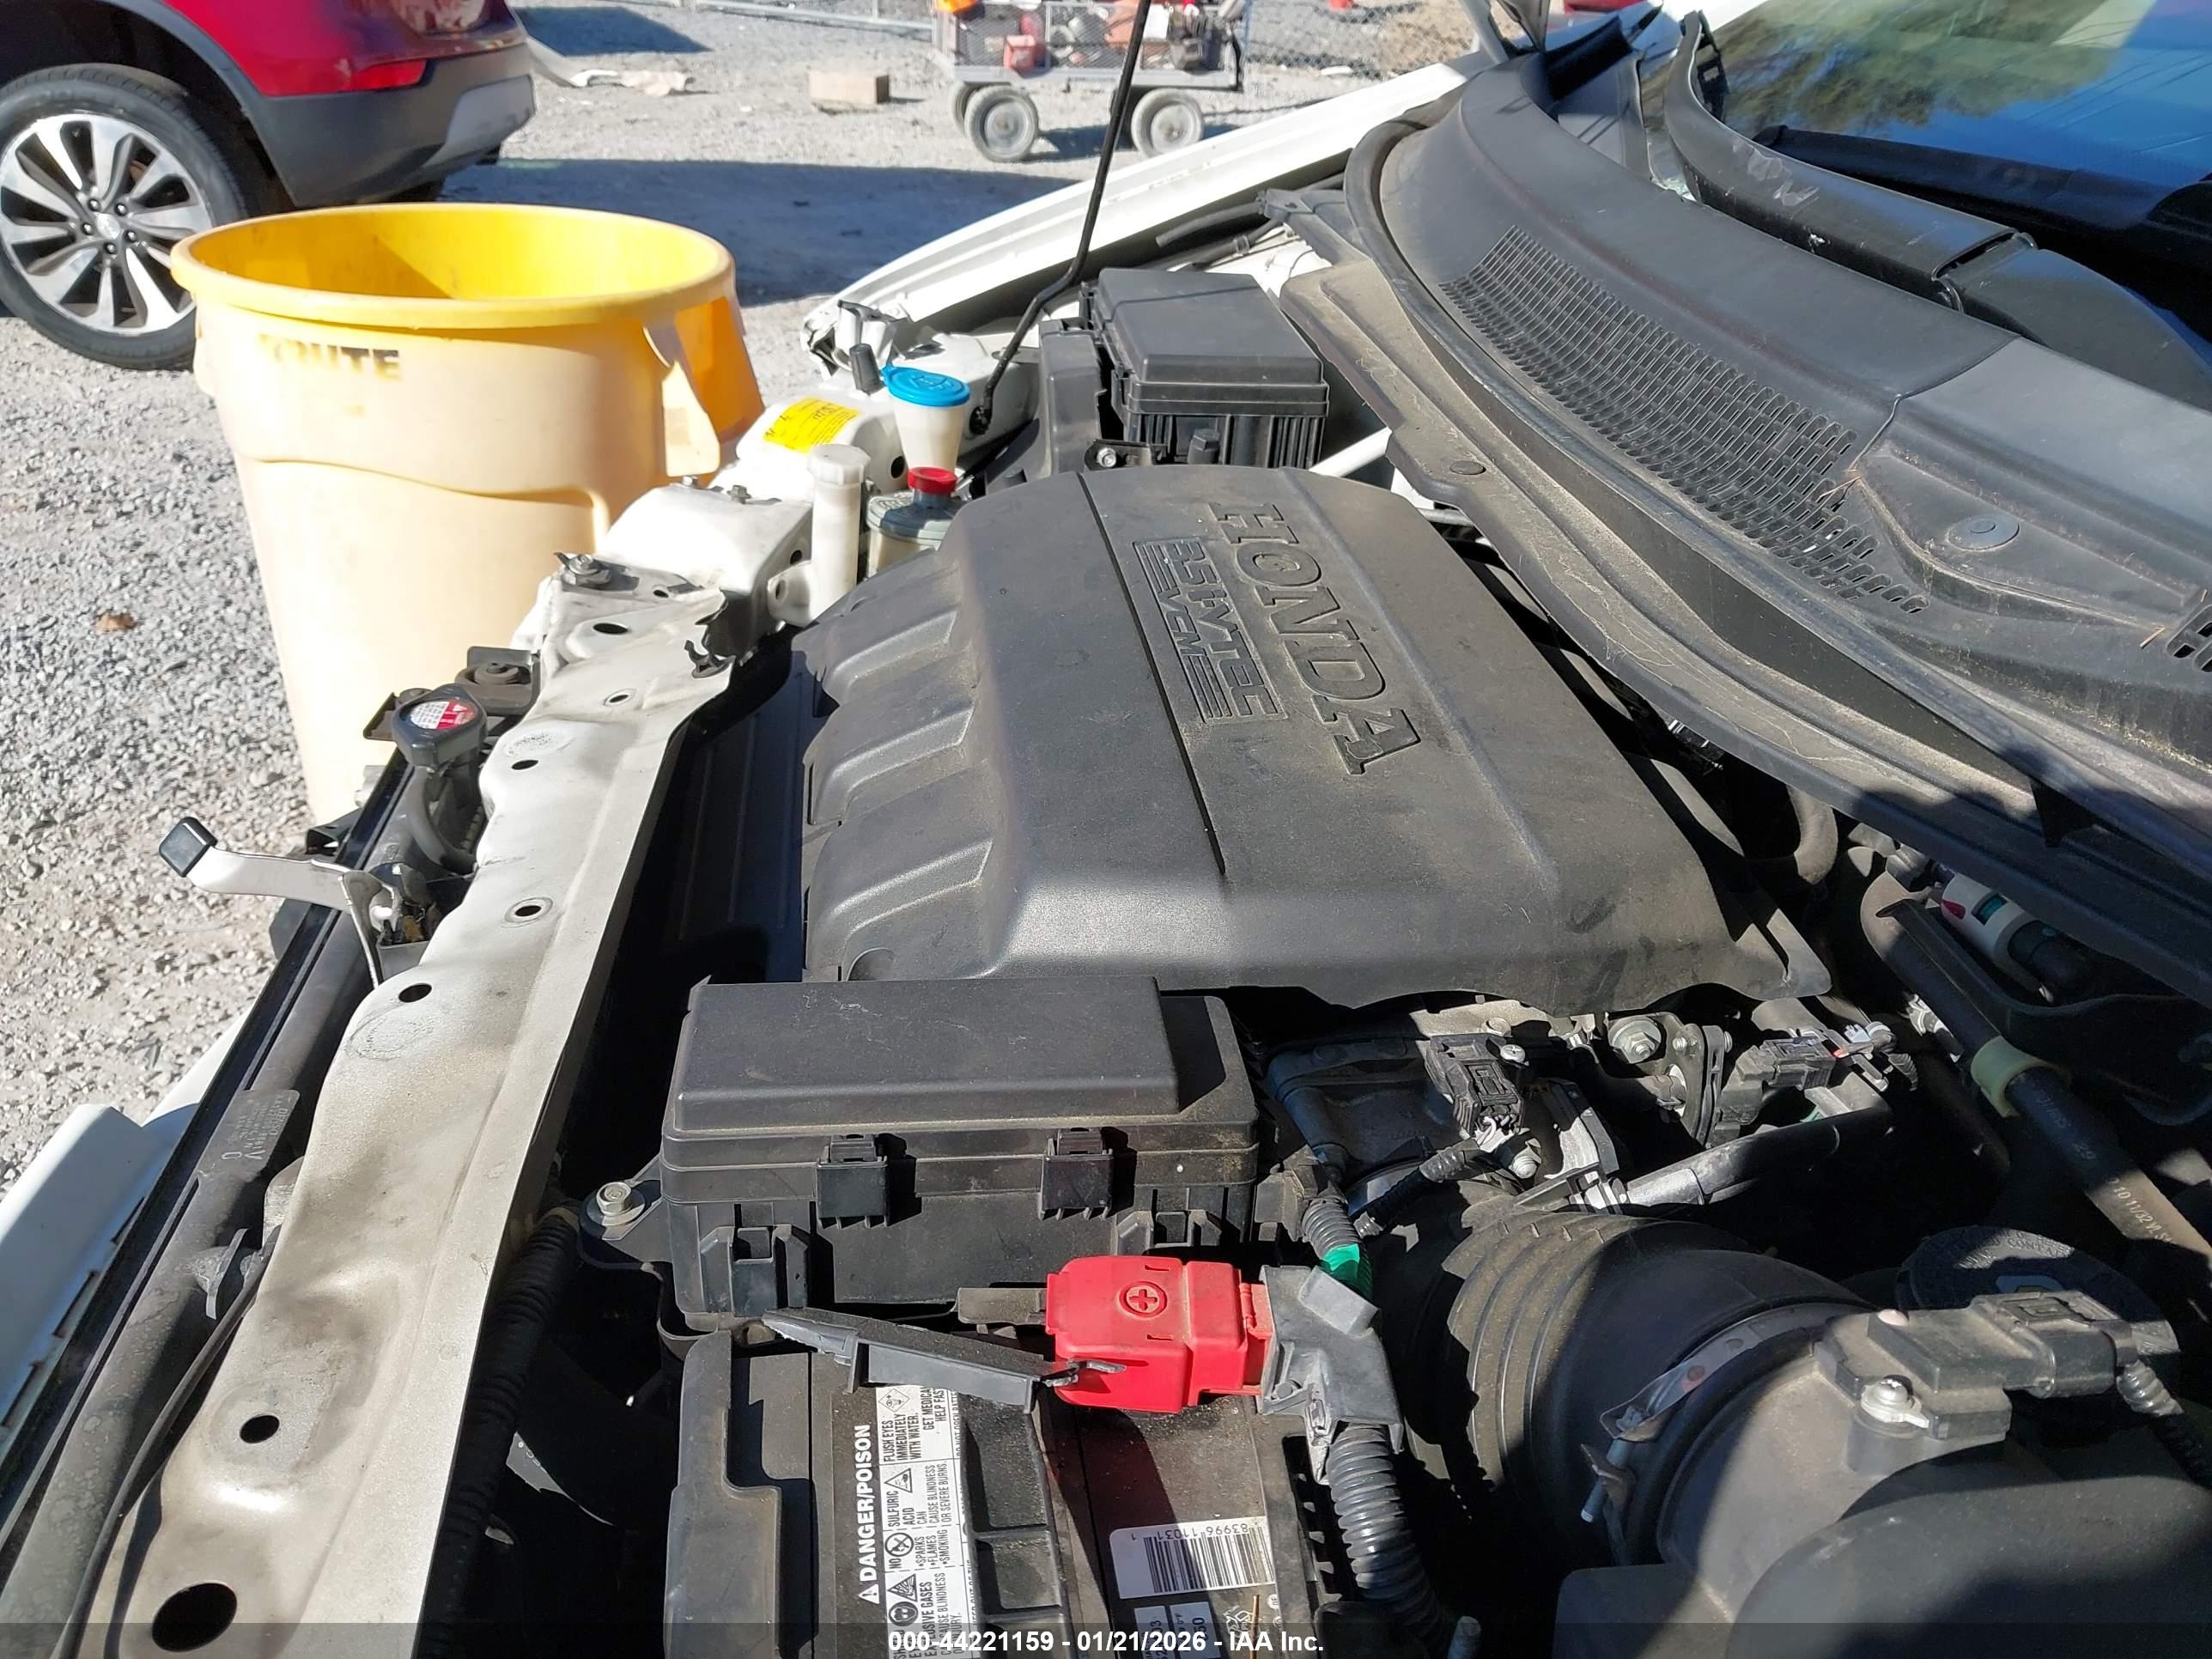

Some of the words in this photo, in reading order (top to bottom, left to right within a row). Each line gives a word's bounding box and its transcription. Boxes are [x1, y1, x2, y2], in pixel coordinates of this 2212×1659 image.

[1158, 586, 1207, 657] VCM
[1207, 502, 1422, 775] HONDA
[269, 1108, 289, 1135] DENSO
[922, 1417, 934, 1431] GET
[934, 1405, 946, 1422] HELP
[882, 1420, 894, 1437] EYES
[894, 1413, 908, 1461] IMMEDIATELY
[883, 1440, 895, 1462] FLUSH
[908, 1440, 921, 1459] WITH
[925, 1465, 938, 1501] BLINDNESS
[854, 1424, 877, 1582] DANGER/POISON
[886, 1491, 900, 1527] SULFURIC
[938, 1486, 951, 1511] SEVERE
[902, 1507, 915, 1525] ACID
[916, 1511, 927, 1525] CAN
[927, 1502, 939, 1524] CAUSE
[940, 1512, 952, 1522] OR
[1157, 1528, 1199, 1540] 11031
[1206, 1523, 1249, 1535] 83996
[888, 1558, 902, 1570] NO
[919, 1582, 933, 1608] GASES
[934, 1572, 948, 1612] BLINDNESS
[921, 1610, 937, 1656] EXLOSIVE
